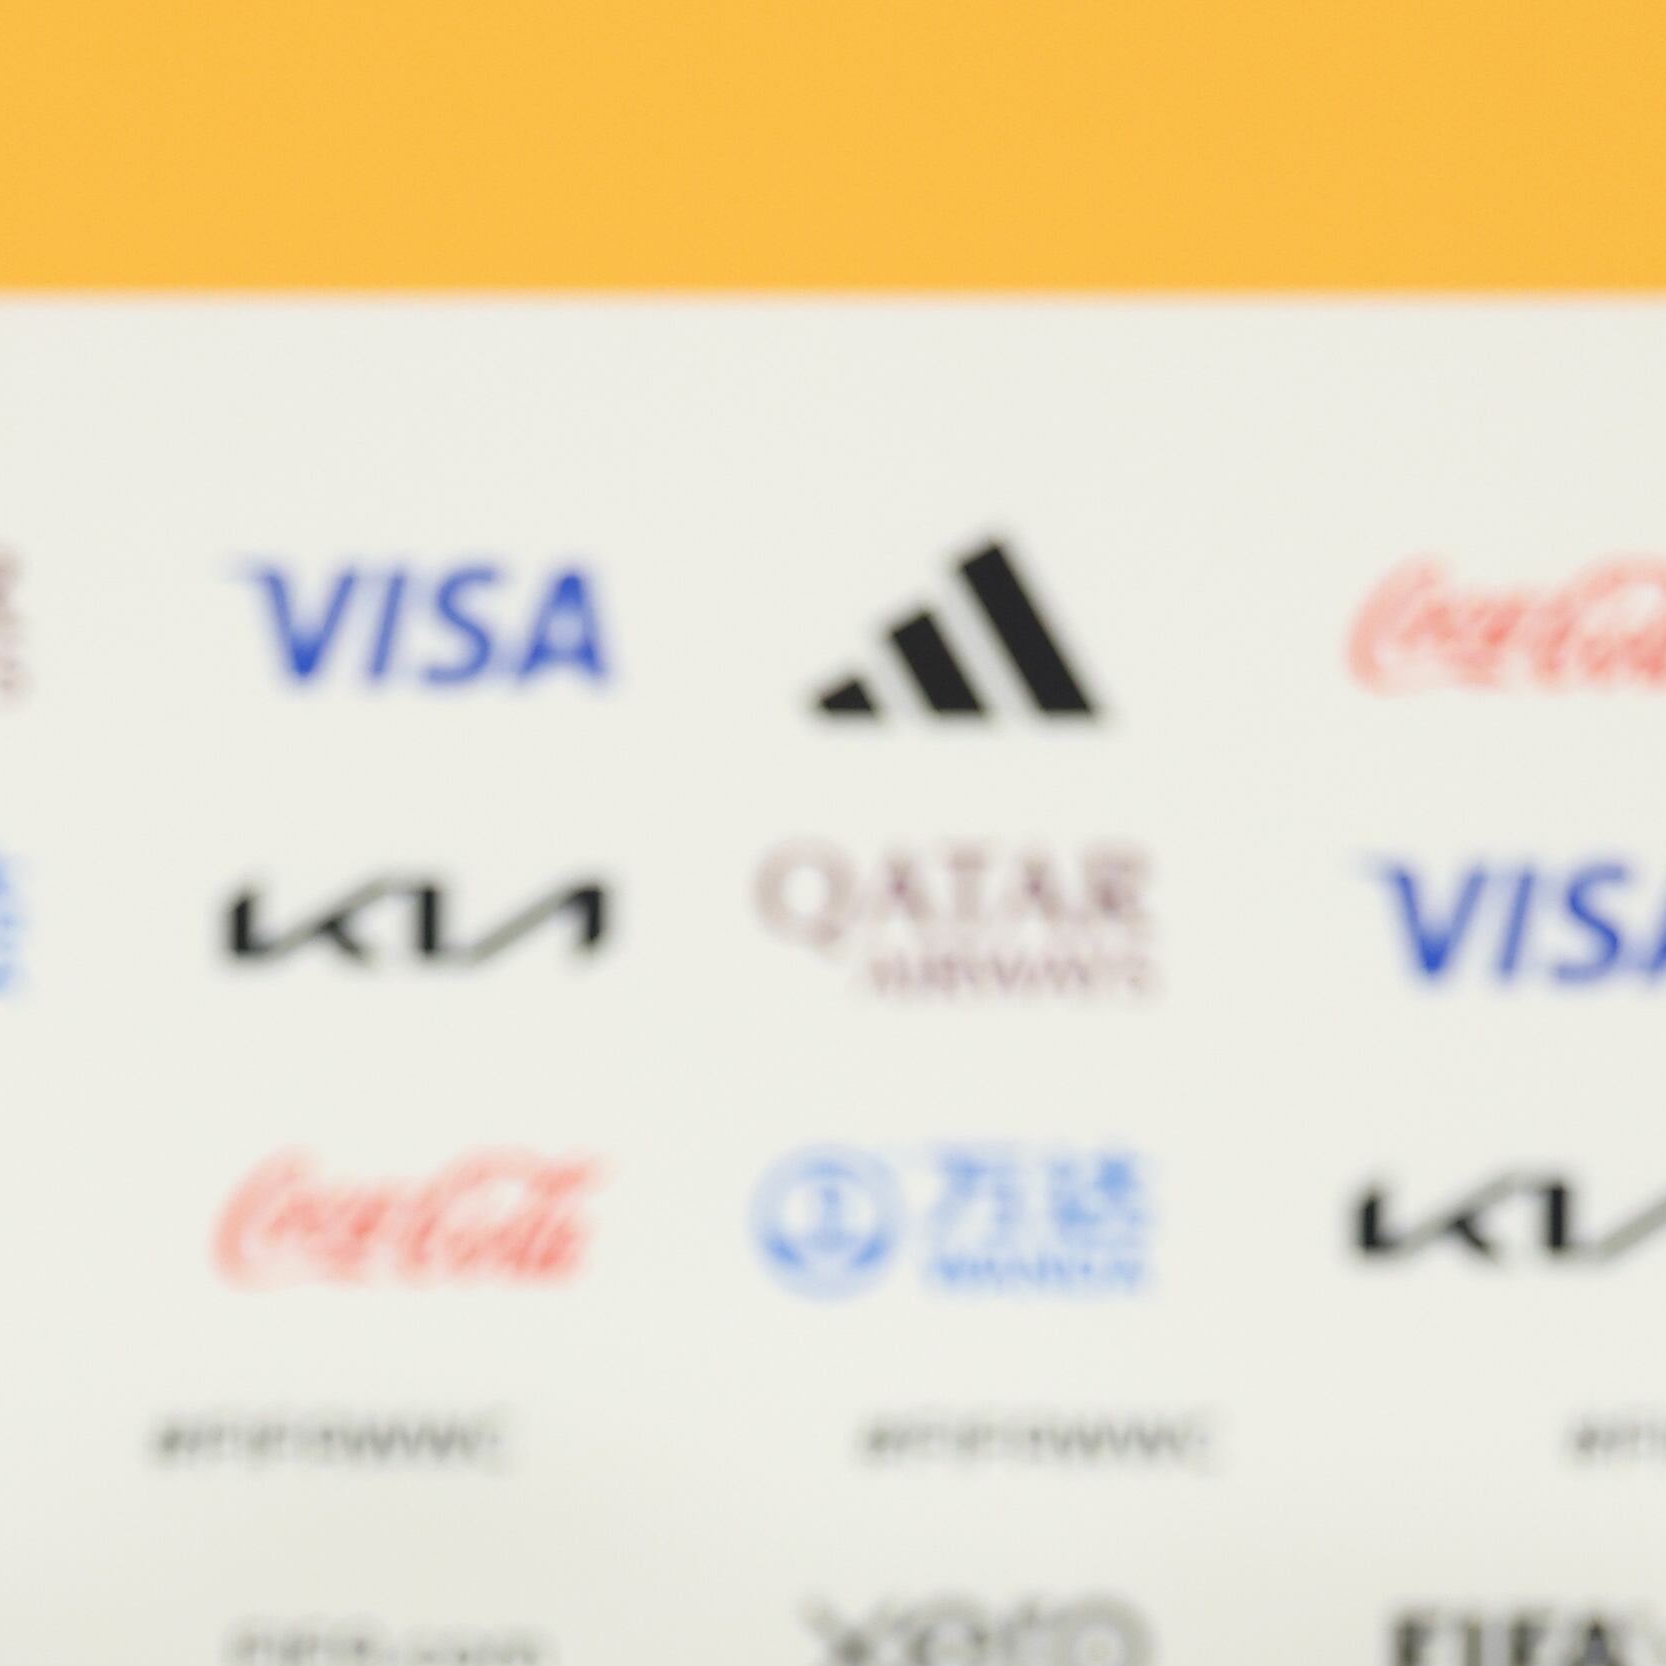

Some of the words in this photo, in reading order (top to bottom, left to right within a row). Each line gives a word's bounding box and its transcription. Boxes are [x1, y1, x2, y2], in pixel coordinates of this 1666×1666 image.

[241, 561, 611, 689] VISA
[221, 877, 613, 965] KIA
[753, 843, 1149, 955] QATAR
[212, 1153, 597, 1284] Coca-Cola
